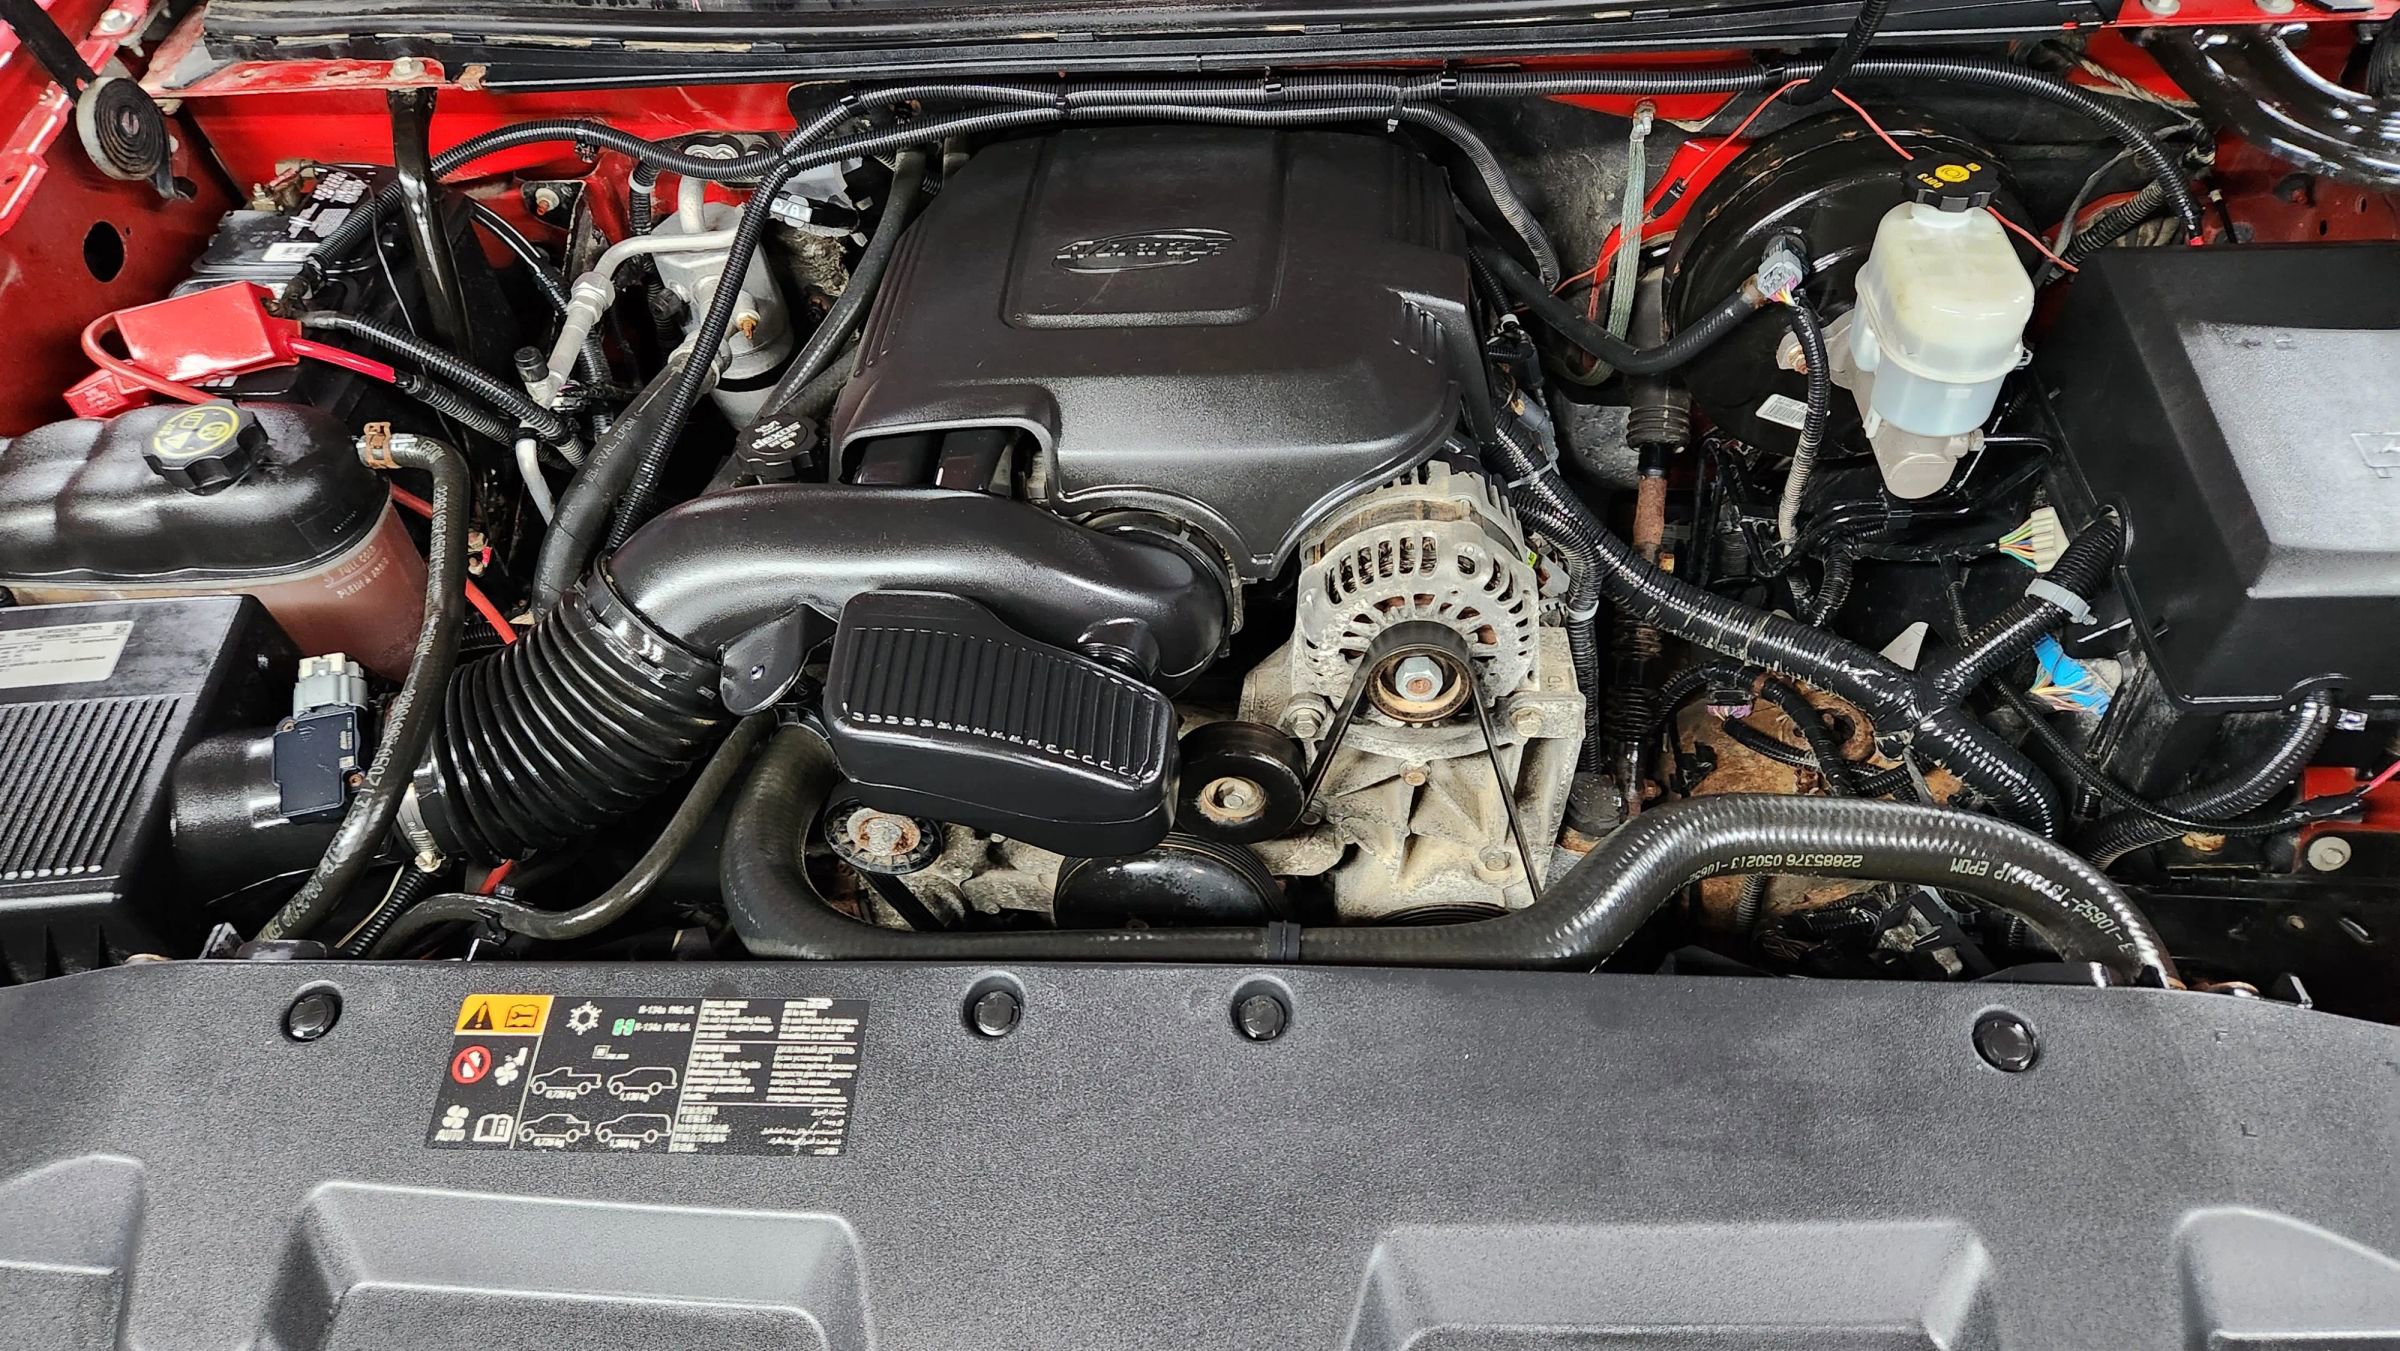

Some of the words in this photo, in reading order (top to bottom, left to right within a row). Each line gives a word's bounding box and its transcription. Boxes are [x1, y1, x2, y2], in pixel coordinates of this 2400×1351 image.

[1786, 853, 1863, 869] 22885376
[1949, 857, 1989, 877] EPDM
[435, 1129, 466, 1142] AUTO
